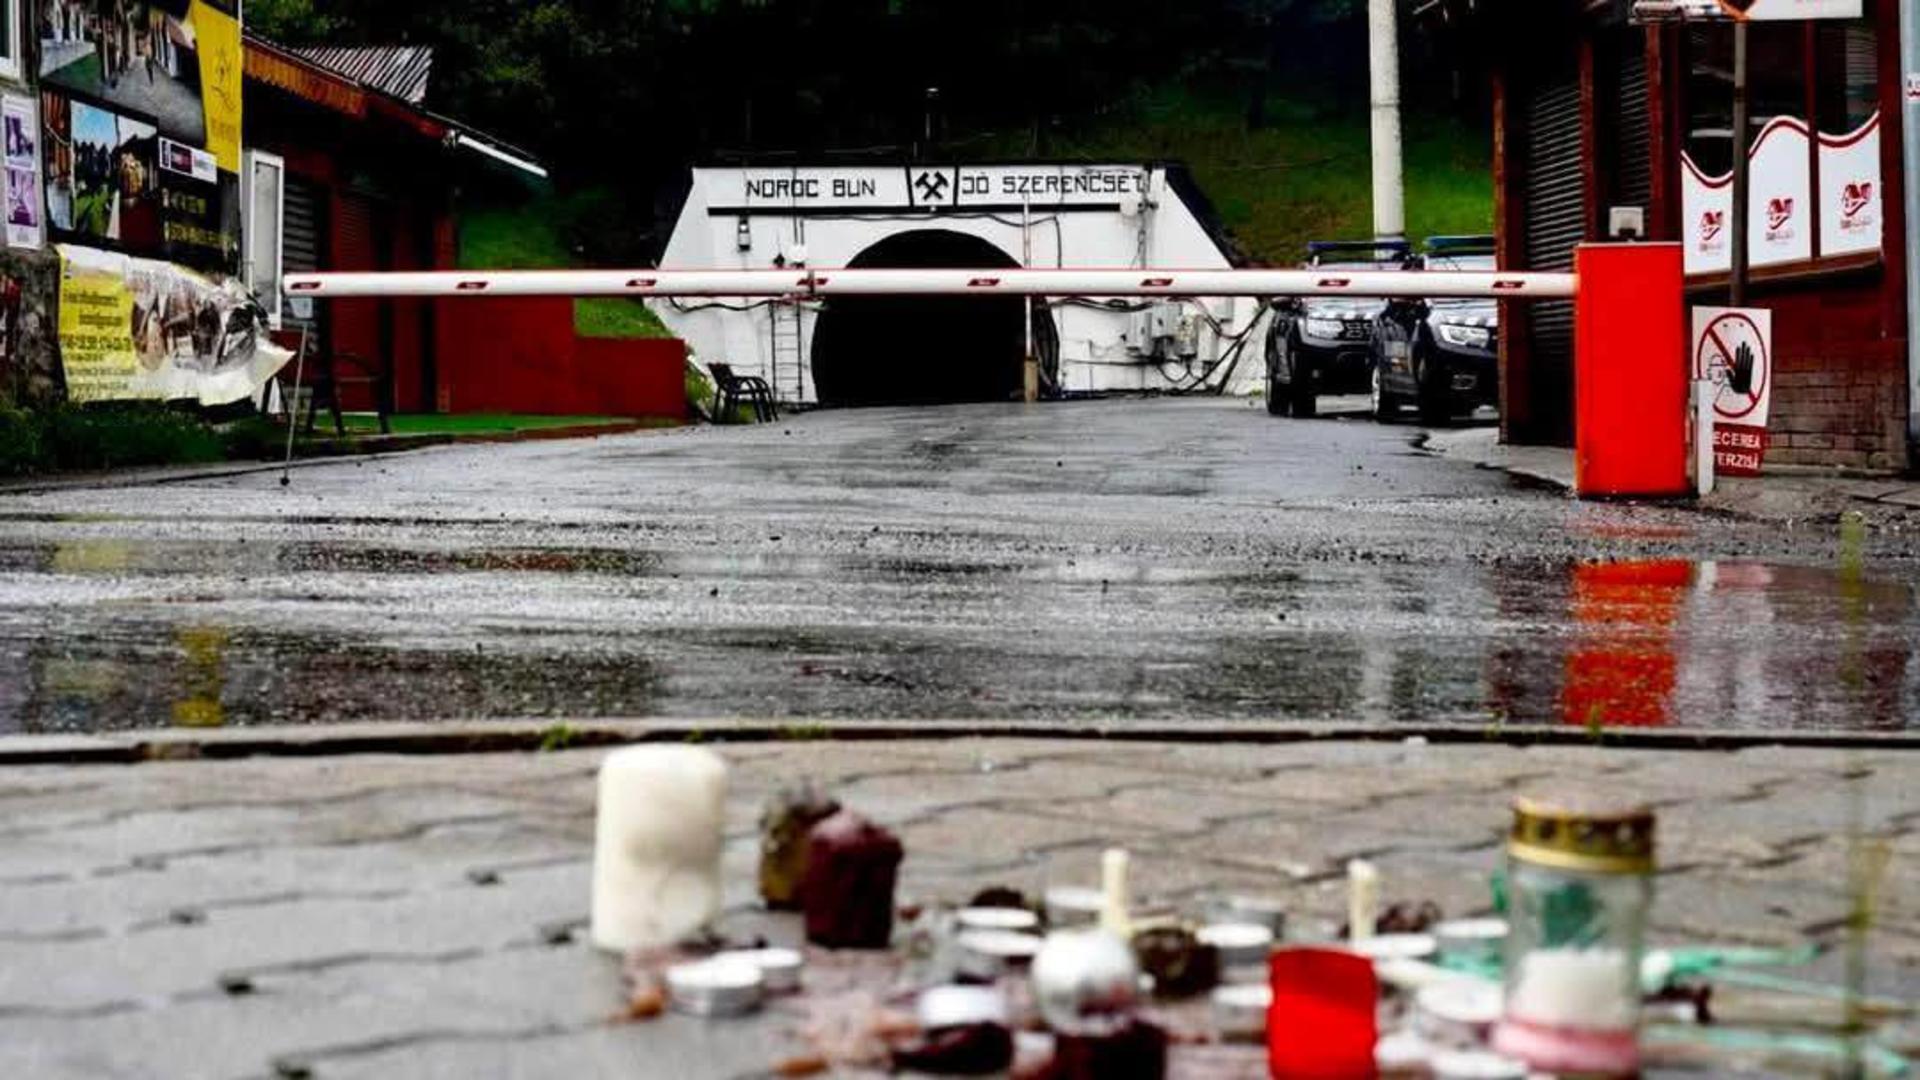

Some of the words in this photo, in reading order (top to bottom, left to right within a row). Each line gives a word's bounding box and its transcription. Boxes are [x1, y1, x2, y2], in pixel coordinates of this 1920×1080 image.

[746, 179, 819, 198] NOROC
[832, 179, 876, 197] BUN
[1713, 431, 1761, 449] ECEREA
